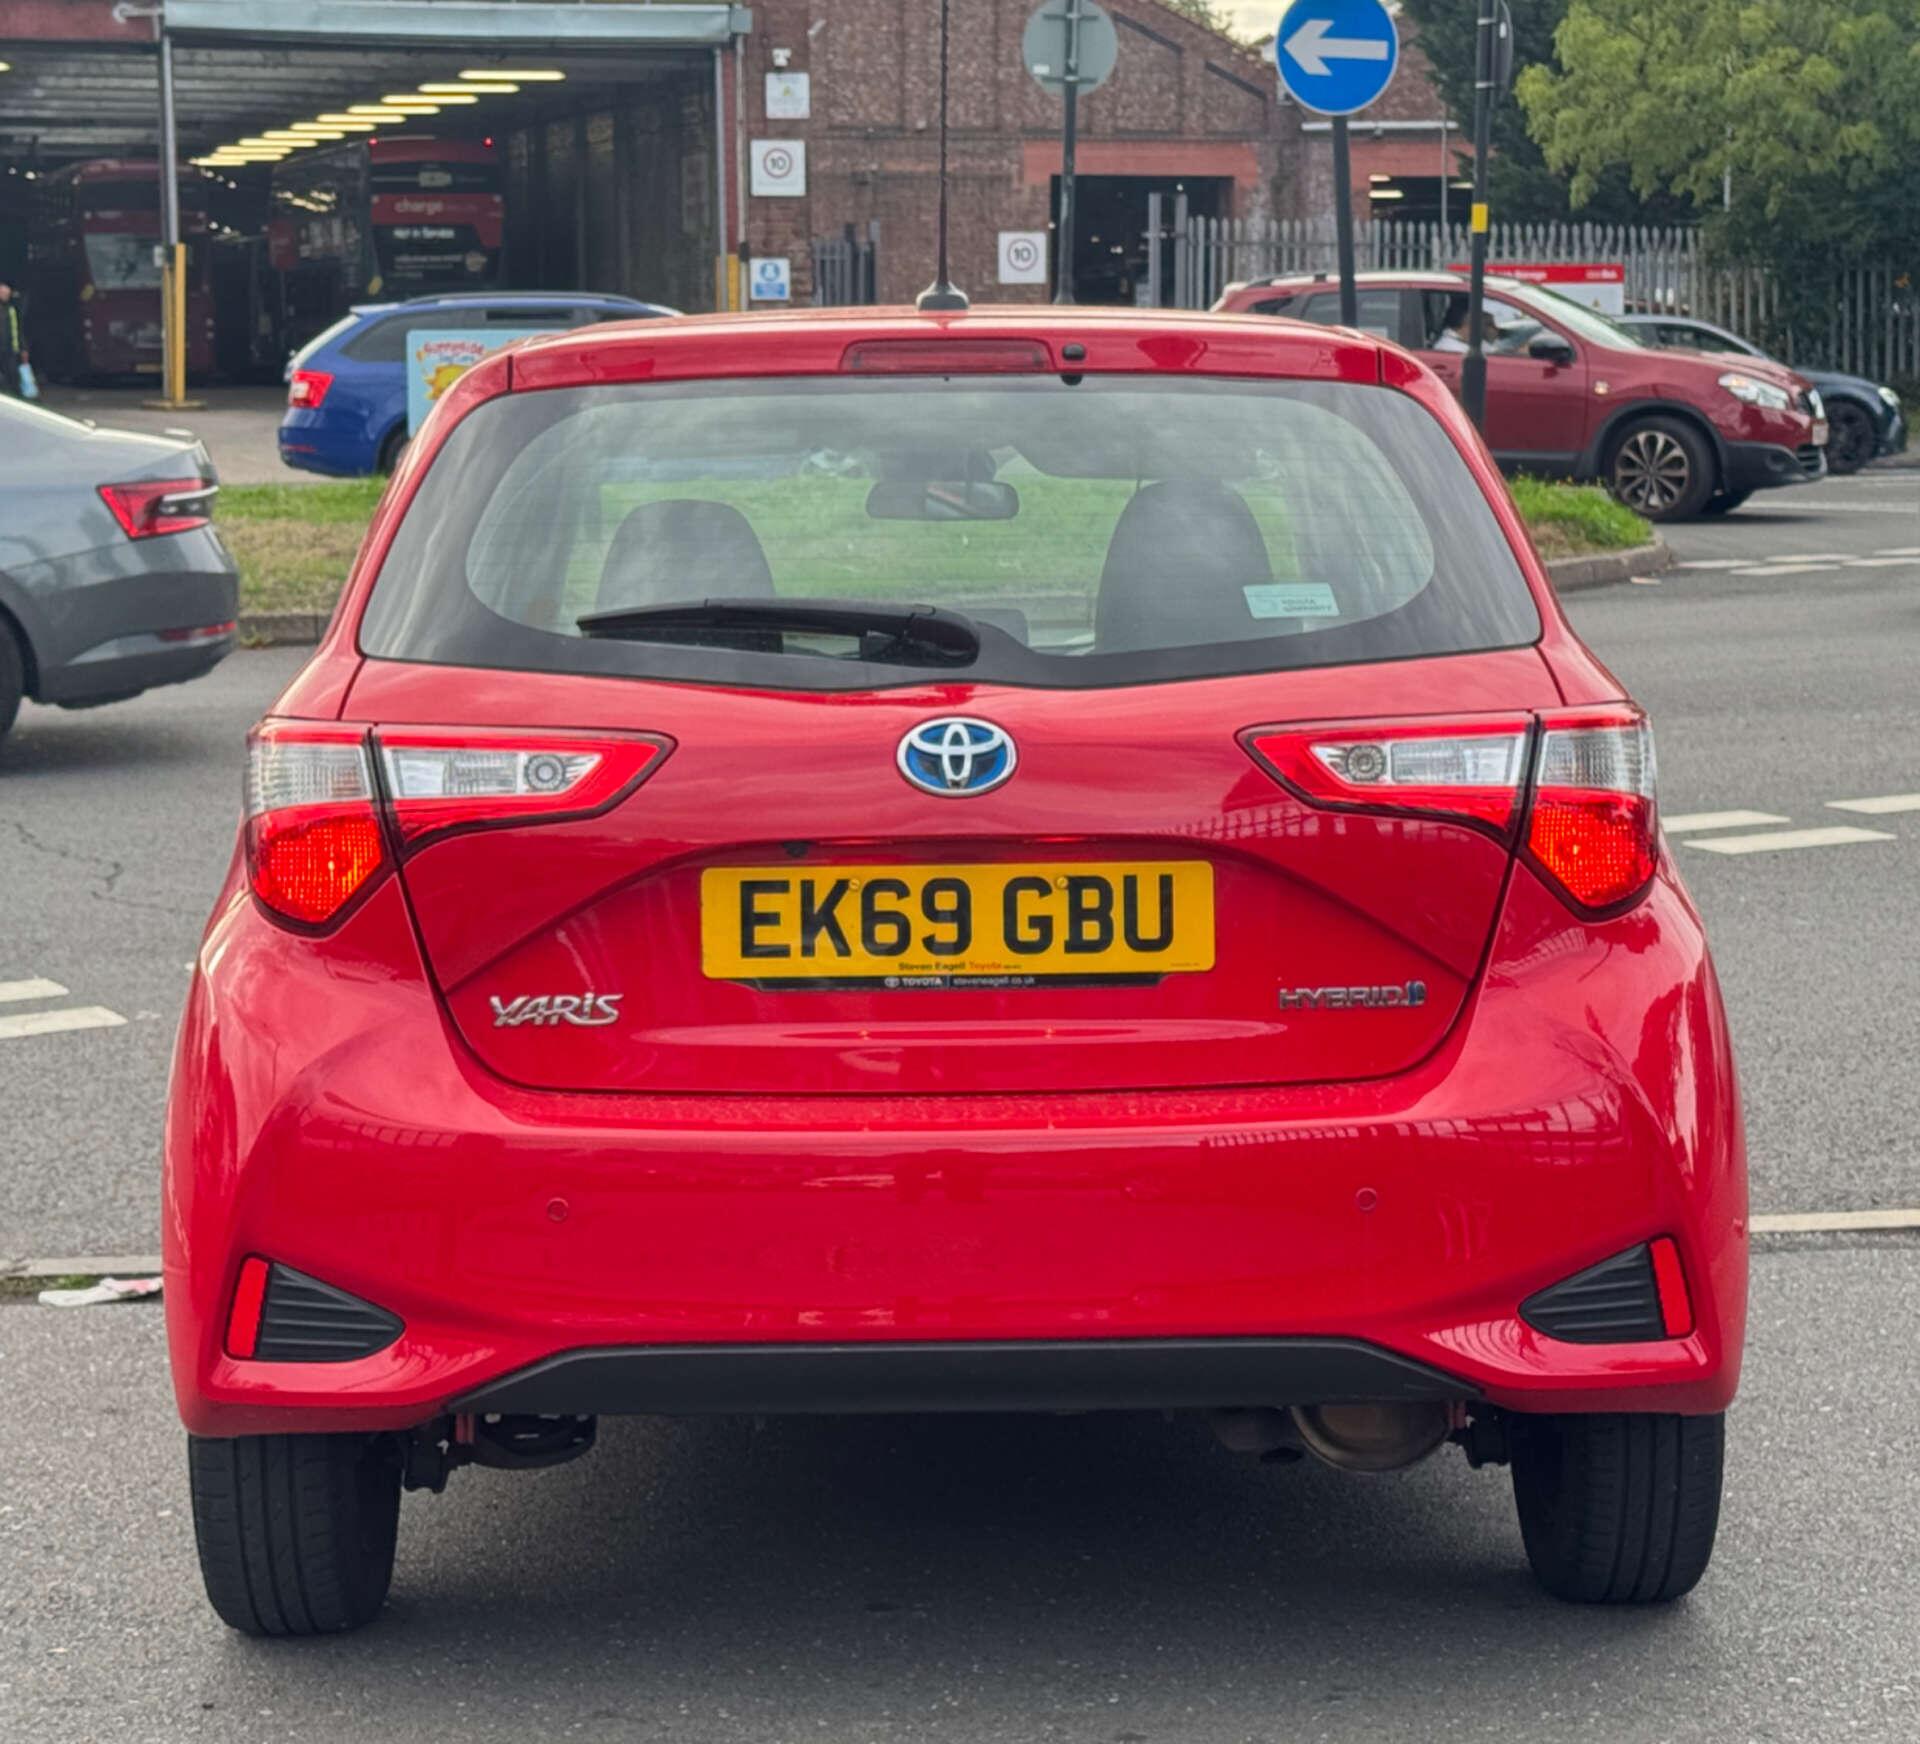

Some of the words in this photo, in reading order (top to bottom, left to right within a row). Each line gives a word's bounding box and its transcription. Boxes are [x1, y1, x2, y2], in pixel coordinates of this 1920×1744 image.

[770, 157, 787, 170] 10
[394, 198, 443, 216] charge
[1014, 247, 1032, 261] 10
[740, 877, 972, 959] EK69
[1003, 874, 1174, 955] GBU
[898, 962, 933, 970] Steven
[935, 961, 966, 971] Eagell
[969, 961, 1001, 970] Toyota
[902, 977, 943, 987] TOYOTA
[1279, 985, 1403, 1009] HYBRID
